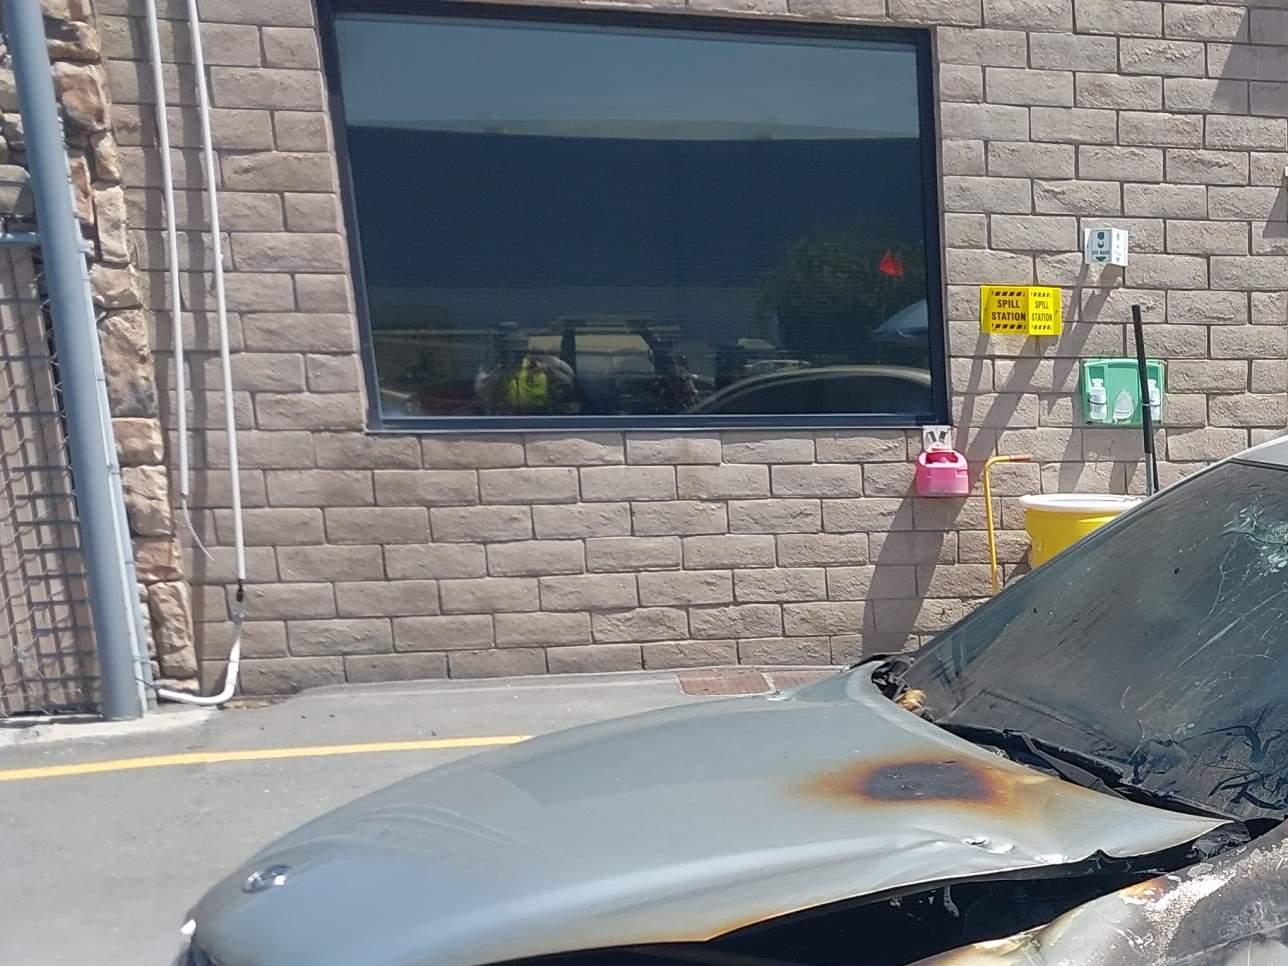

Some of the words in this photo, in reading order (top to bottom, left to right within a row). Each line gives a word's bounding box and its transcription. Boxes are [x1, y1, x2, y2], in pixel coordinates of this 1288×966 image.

[997, 299, 1020, 309] SPILL
[1035, 301, 1049, 310] SPILL
[991, 312, 1026, 321] STATION
[1032, 313, 1052, 321] STATION
